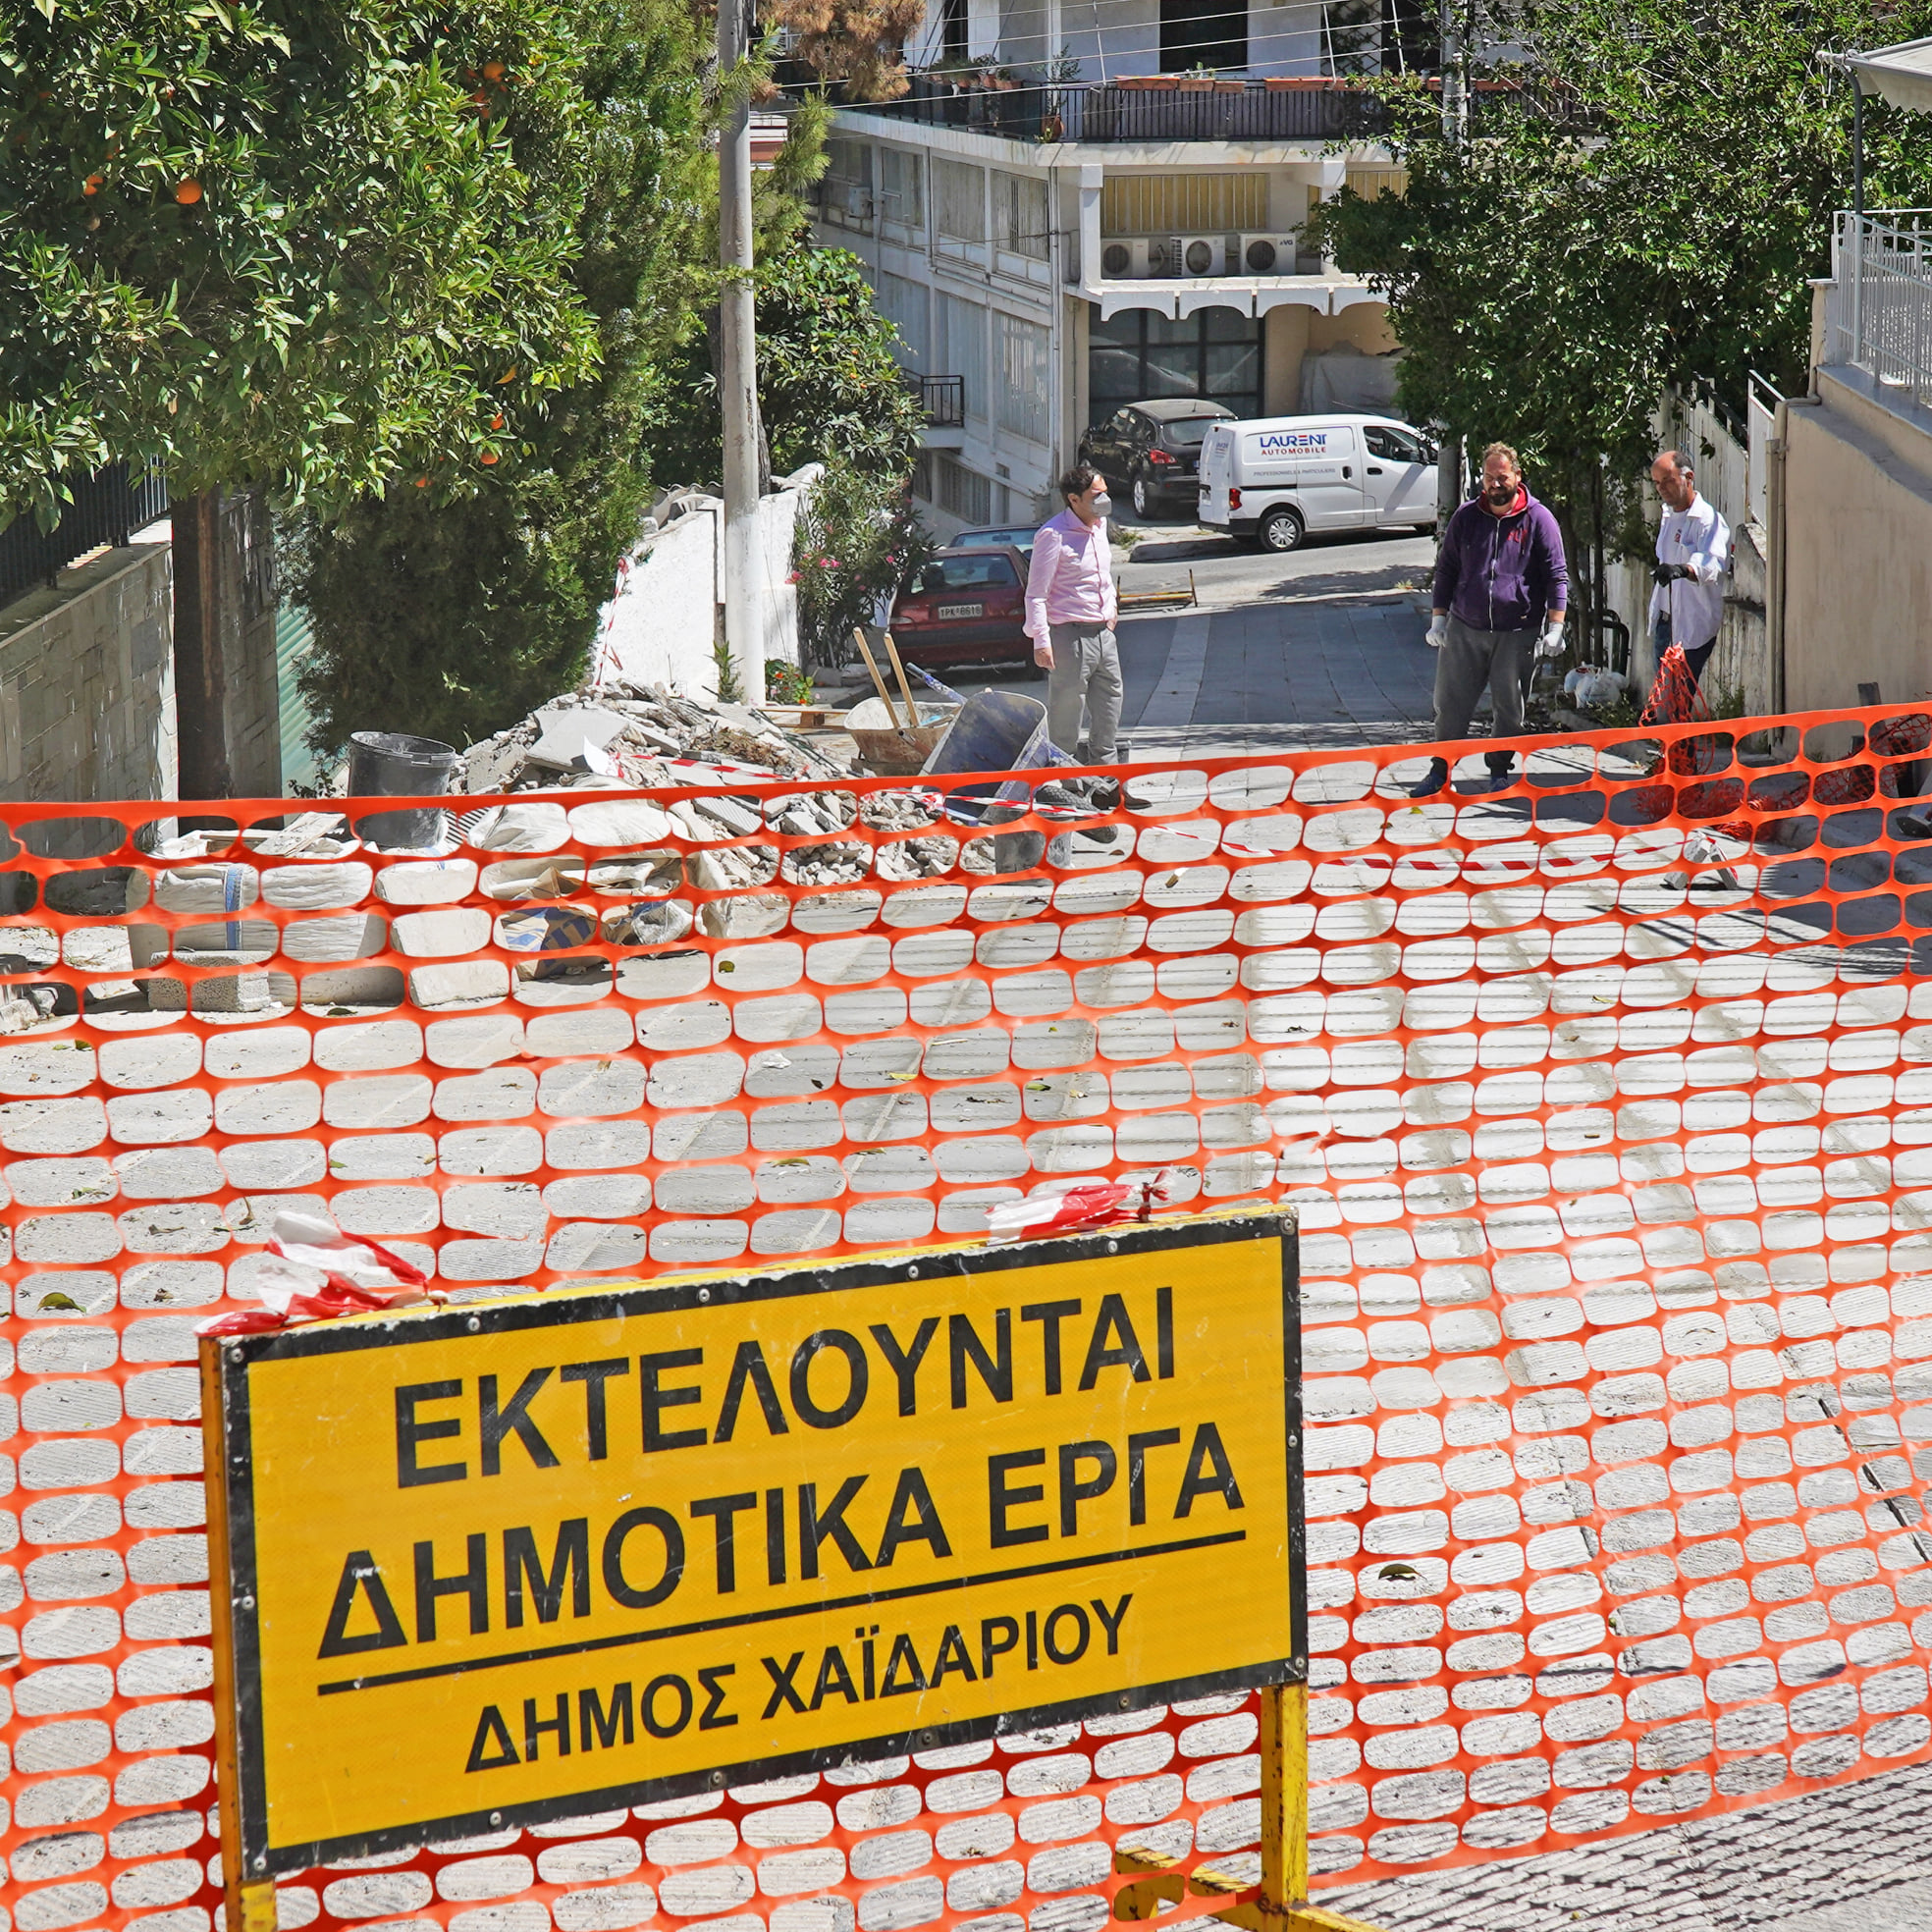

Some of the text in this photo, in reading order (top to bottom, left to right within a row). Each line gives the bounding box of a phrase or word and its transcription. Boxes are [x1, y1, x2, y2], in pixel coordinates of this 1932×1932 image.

[1260, 434, 1327, 448] LAURENT
[1261, 447, 1327, 456] AUTOMOBILE
[395, 1286, 1175, 1489] ΕΚΤΕΛΟΥΝΤΑΙ
[317, 1422, 1246, 1661] ΔΗΜΟΤΙΚΑ ΕΡΓΑ
[465, 1592, 1134, 1774] ΔΗΜΟΣ ΧΑΪΔΑΡΙΟΥ
